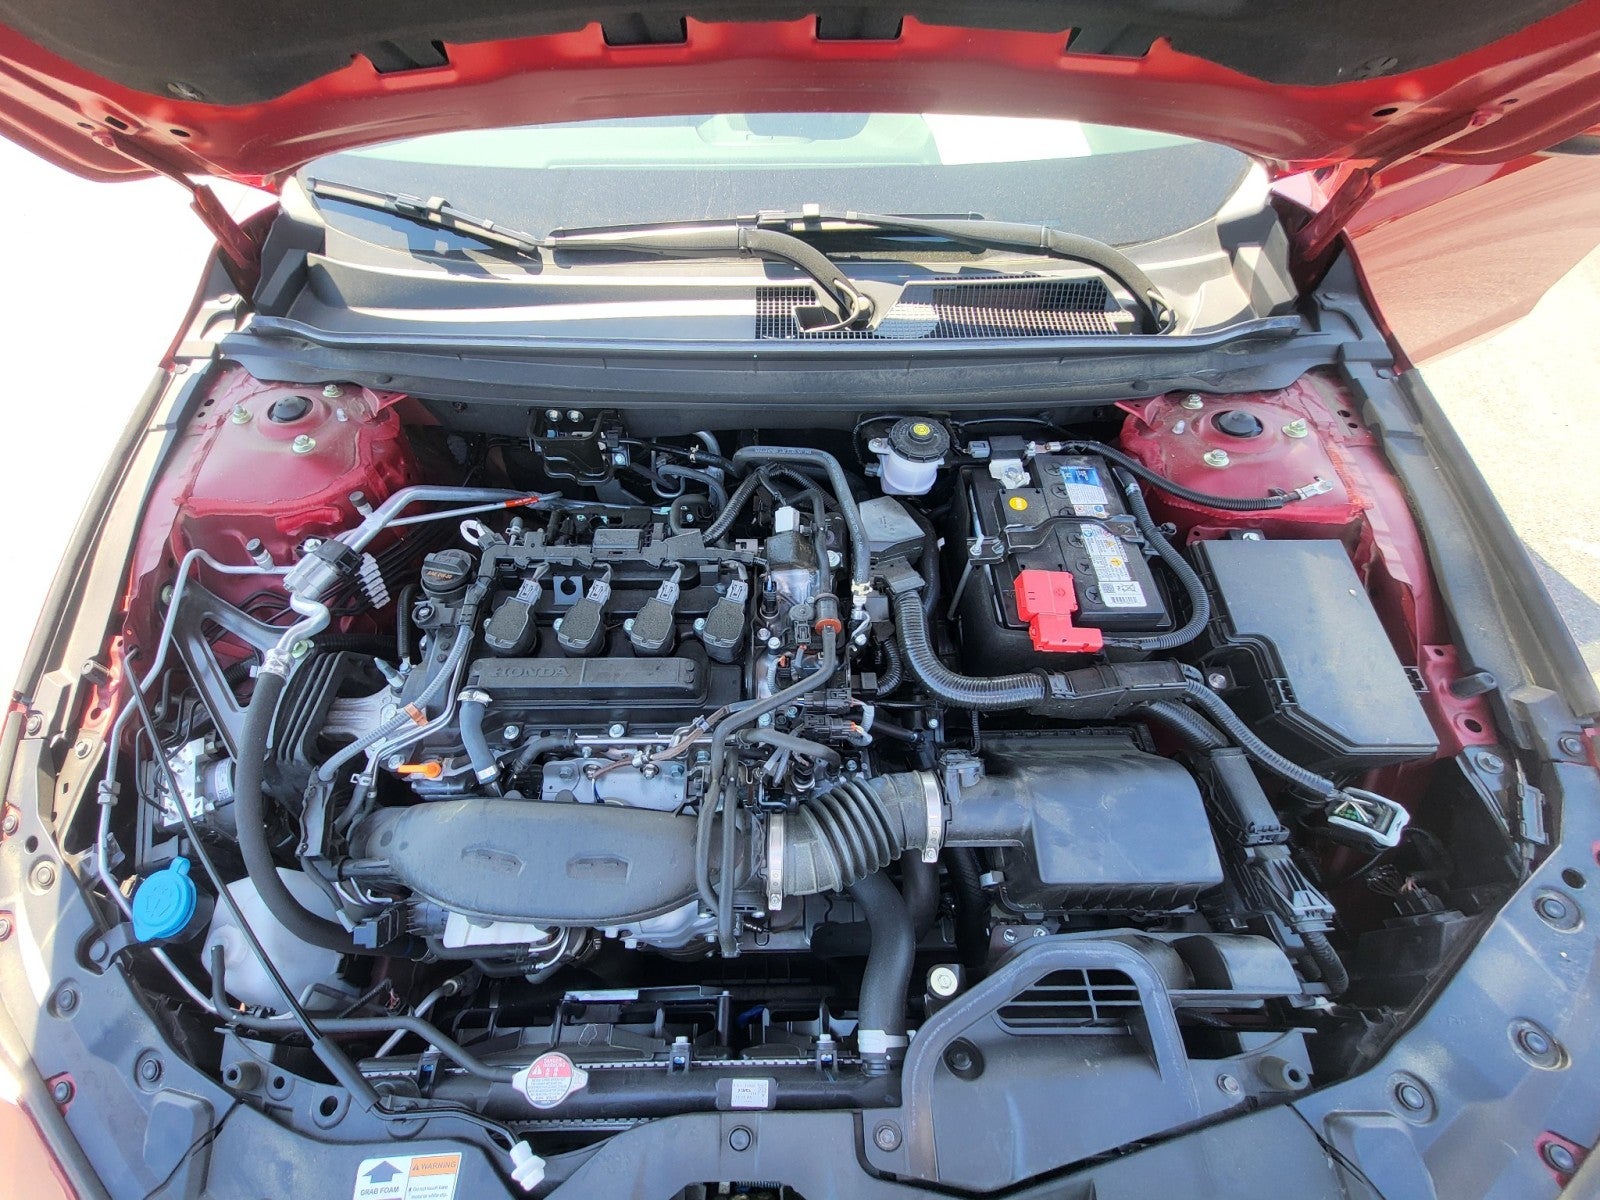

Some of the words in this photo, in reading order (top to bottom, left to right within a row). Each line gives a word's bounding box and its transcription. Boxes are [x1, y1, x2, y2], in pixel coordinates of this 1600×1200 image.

[490, 666, 571, 678] HONDA
[421, 1161, 457, 1170] WARNING
[360, 1187, 379, 1196] GRAB
[379, 1186, 400, 1194] FOAM
